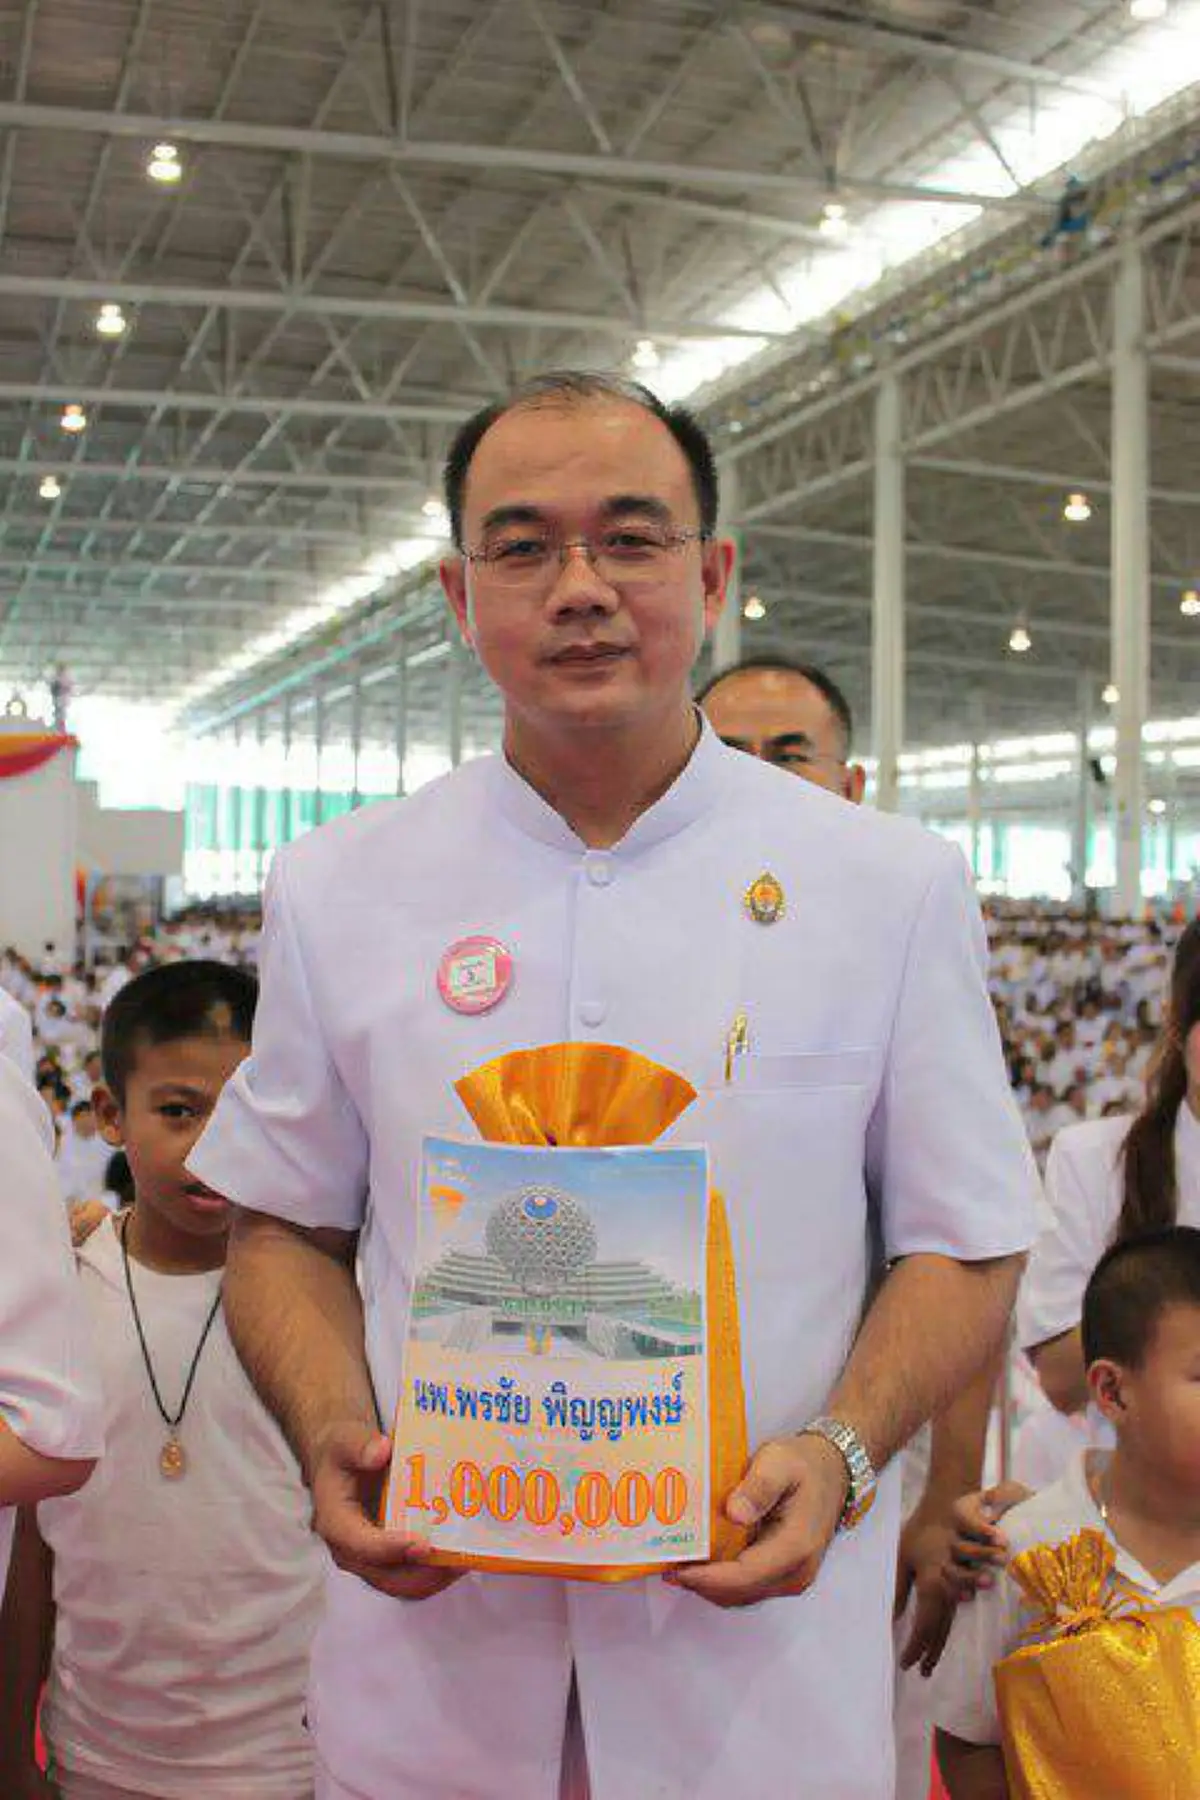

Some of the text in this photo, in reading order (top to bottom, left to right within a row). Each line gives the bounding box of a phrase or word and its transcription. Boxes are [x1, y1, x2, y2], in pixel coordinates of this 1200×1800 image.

[413, 1370, 684, 1441] นพ.พรชัย พิญญพงษ์
[403, 1453, 689, 1536] 1,000,000
